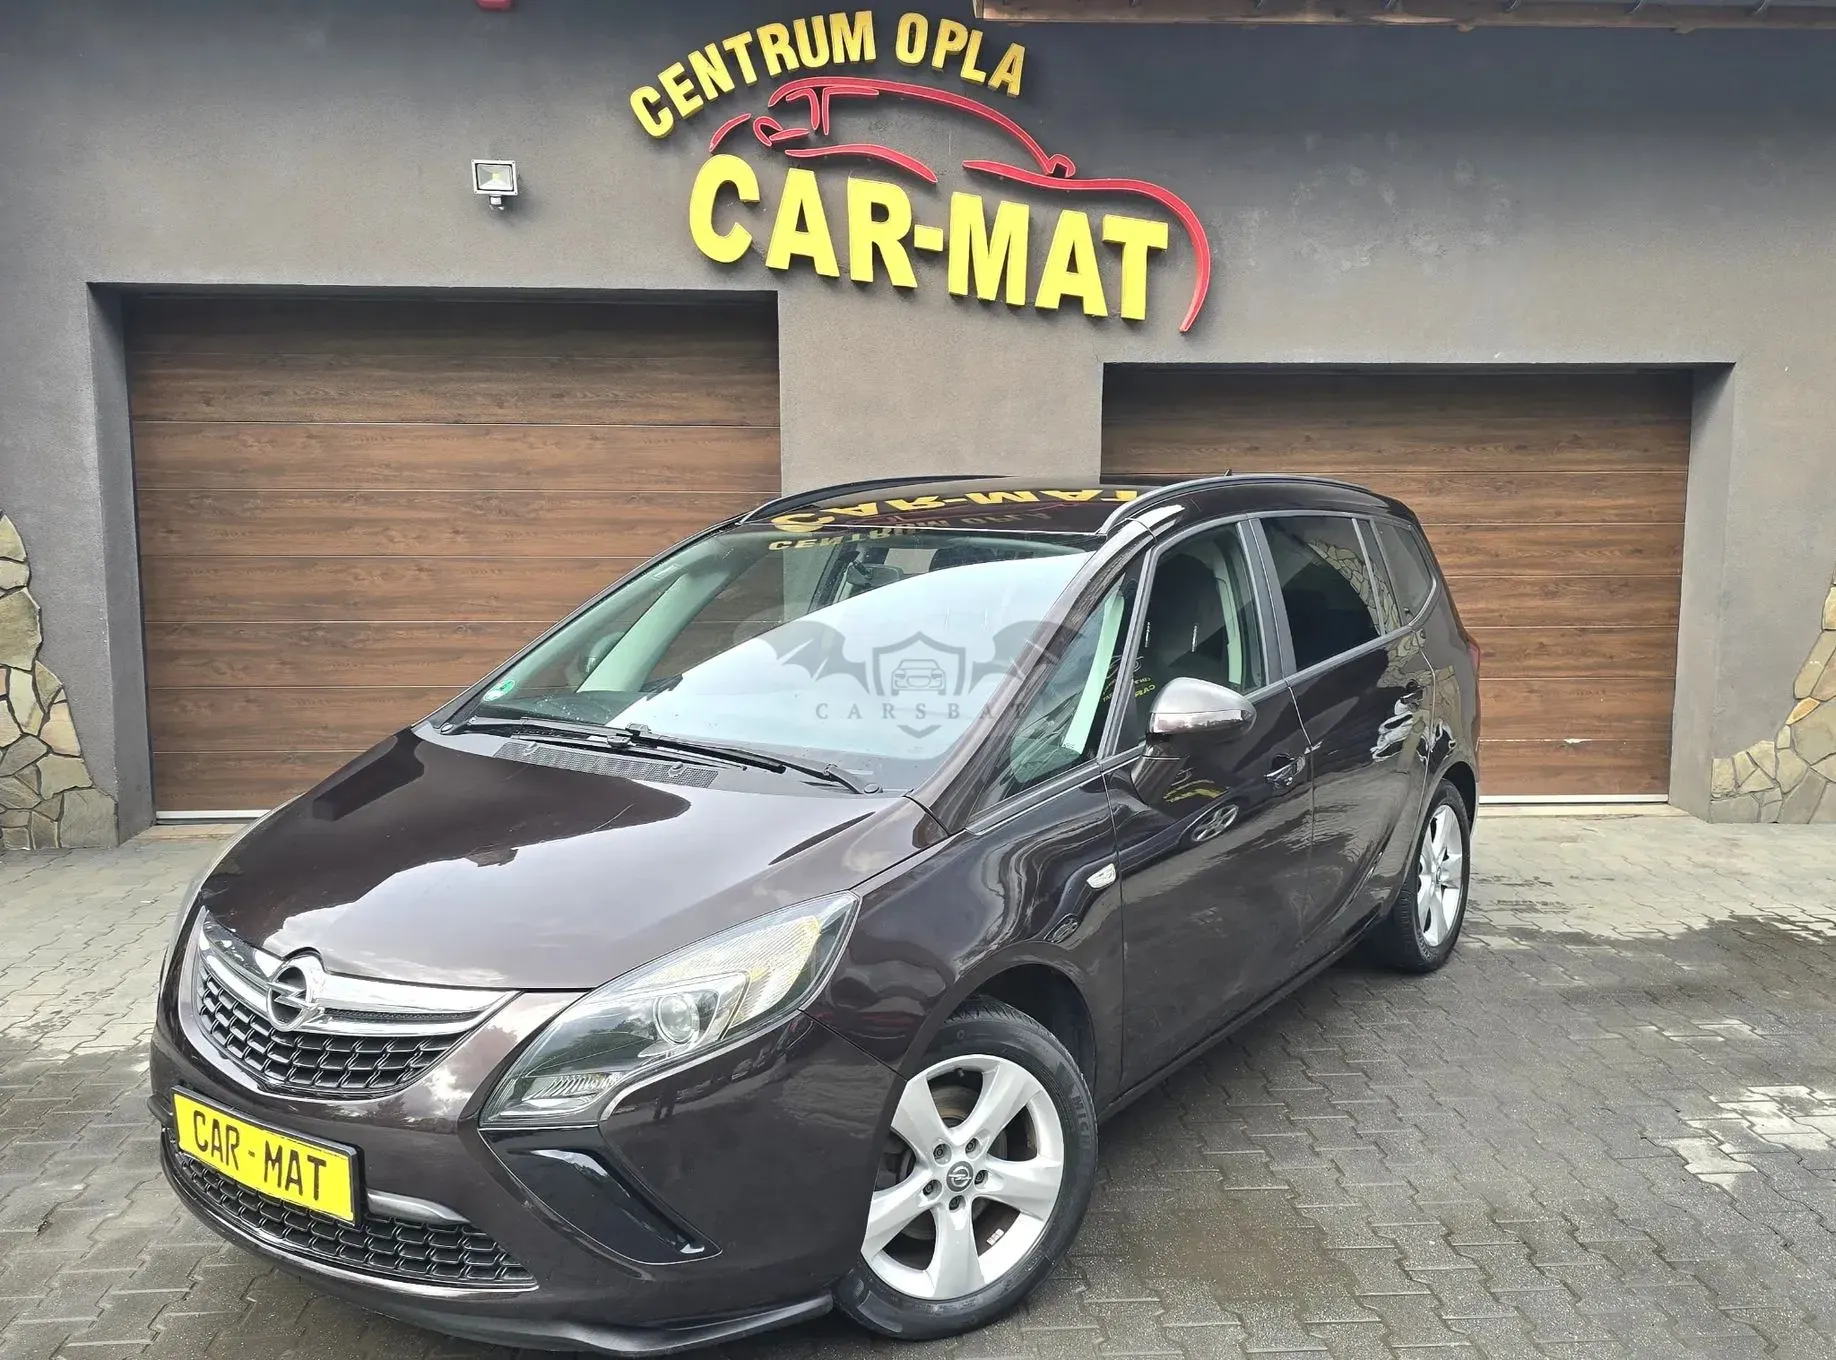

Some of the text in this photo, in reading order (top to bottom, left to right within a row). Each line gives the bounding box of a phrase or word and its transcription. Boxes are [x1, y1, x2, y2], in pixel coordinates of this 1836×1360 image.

[630, 10, 1027, 140] CENTRUM OPLA
[689, 154, 1169, 321] CAR-MAT
[193, 1109, 240, 1171] CAR
[263, 1139, 327, 1201] MAT
